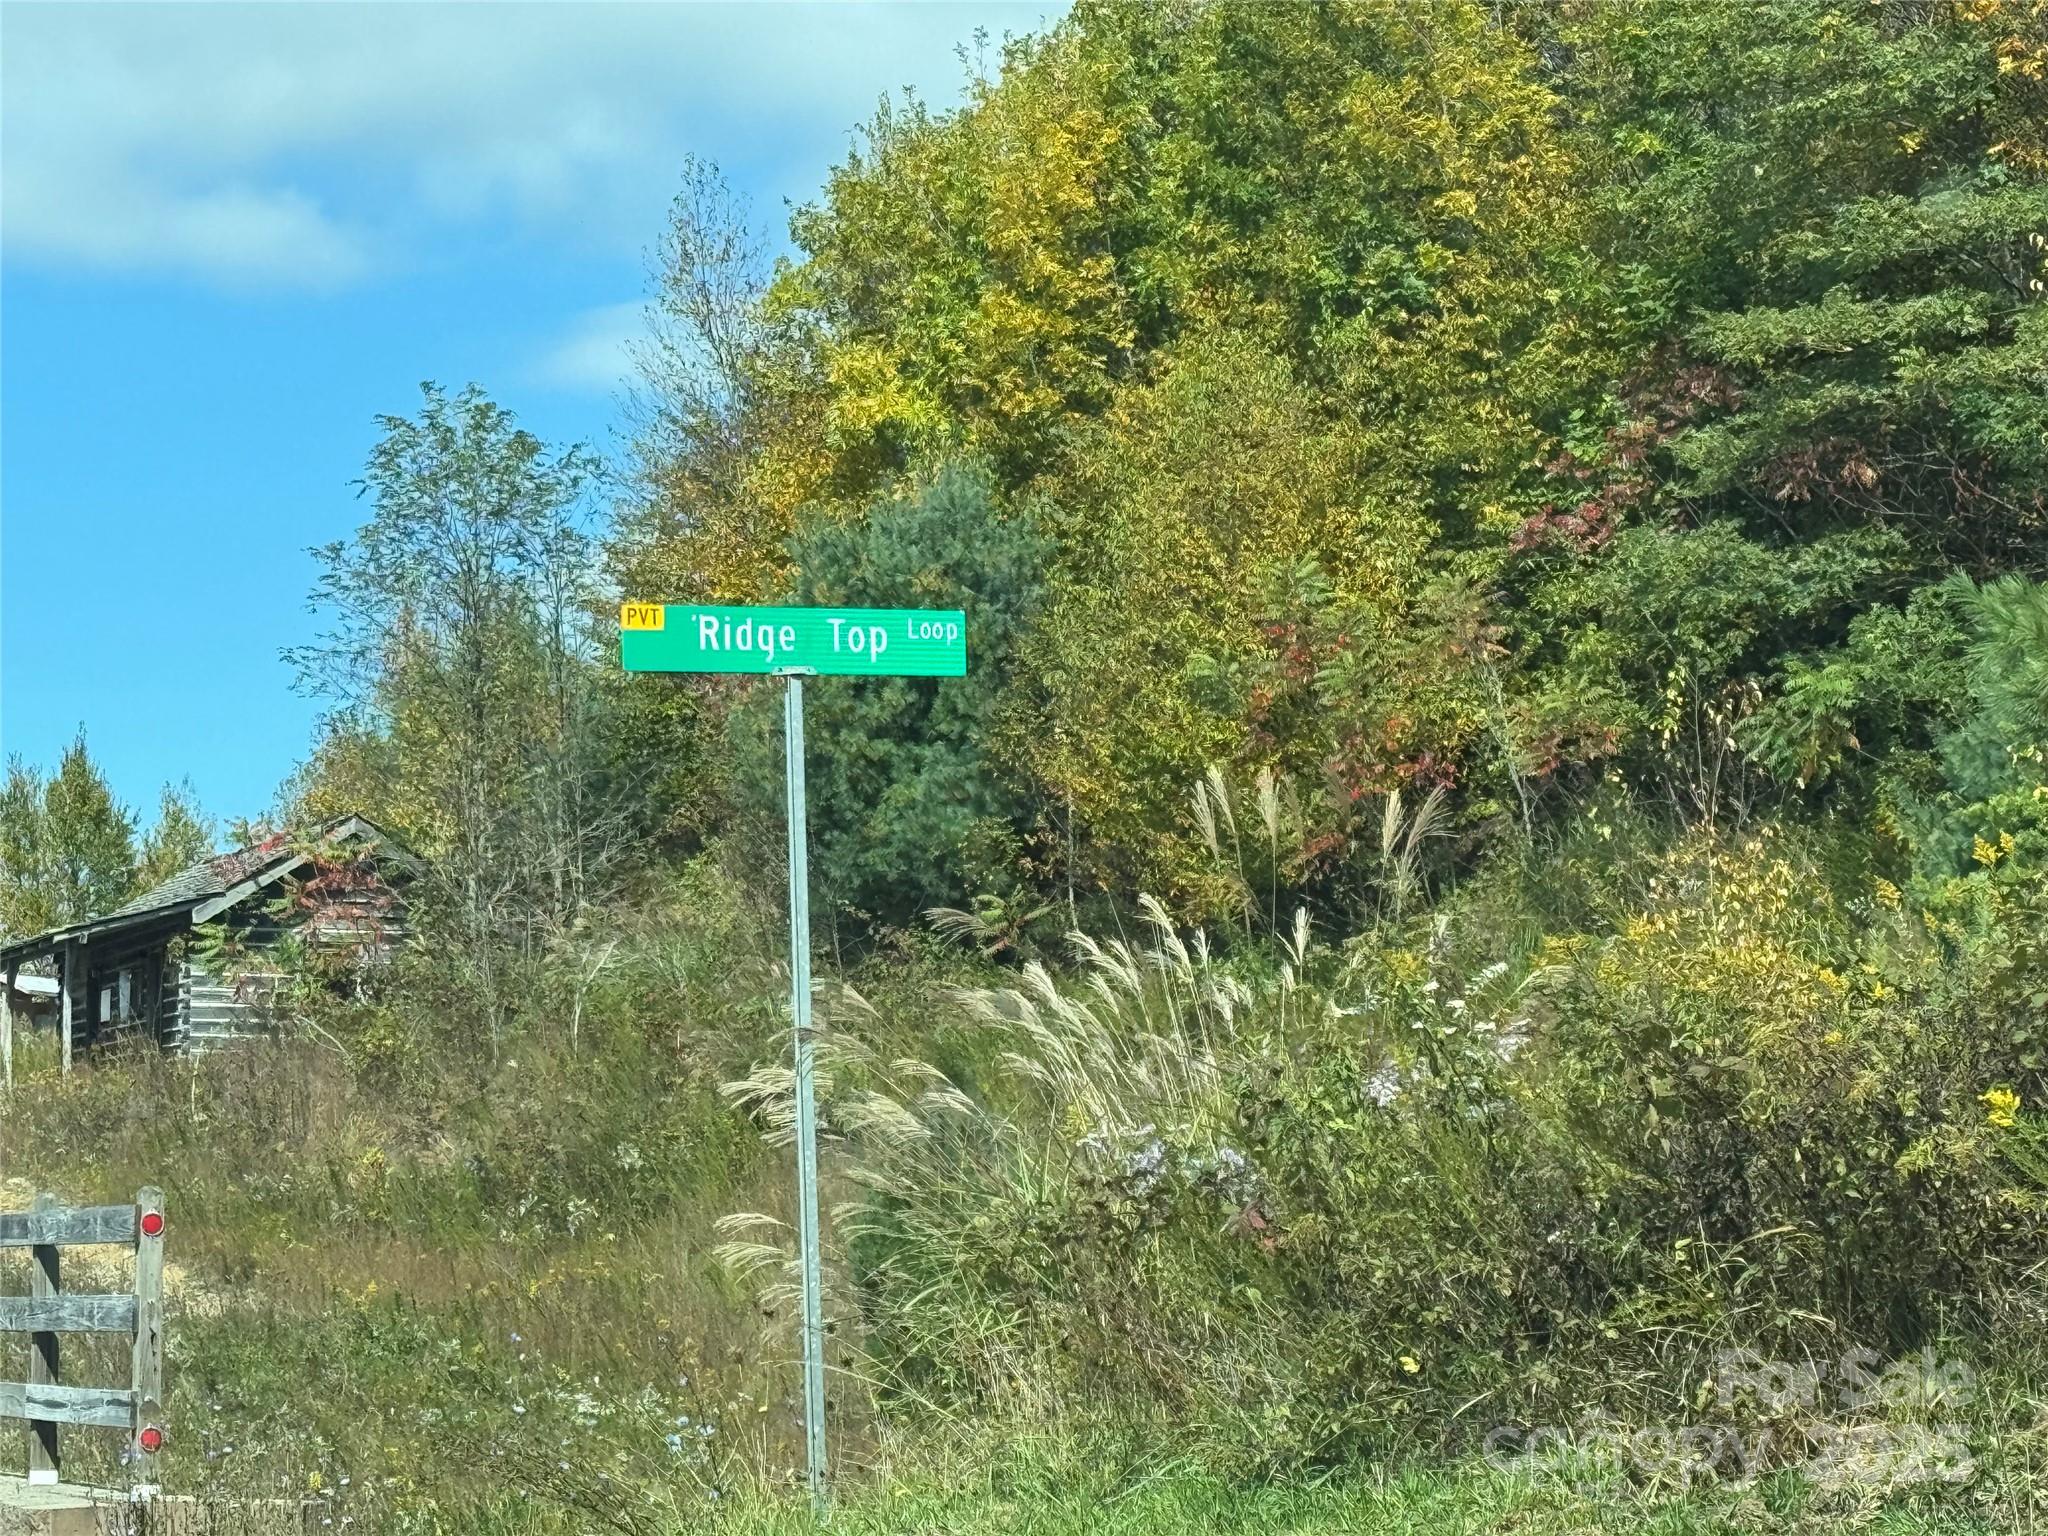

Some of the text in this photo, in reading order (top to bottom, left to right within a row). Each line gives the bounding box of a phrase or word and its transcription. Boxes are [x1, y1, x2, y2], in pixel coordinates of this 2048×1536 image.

[626, 607, 659, 626] PVT
[698, 614, 958, 663] Ridge Top Loop
